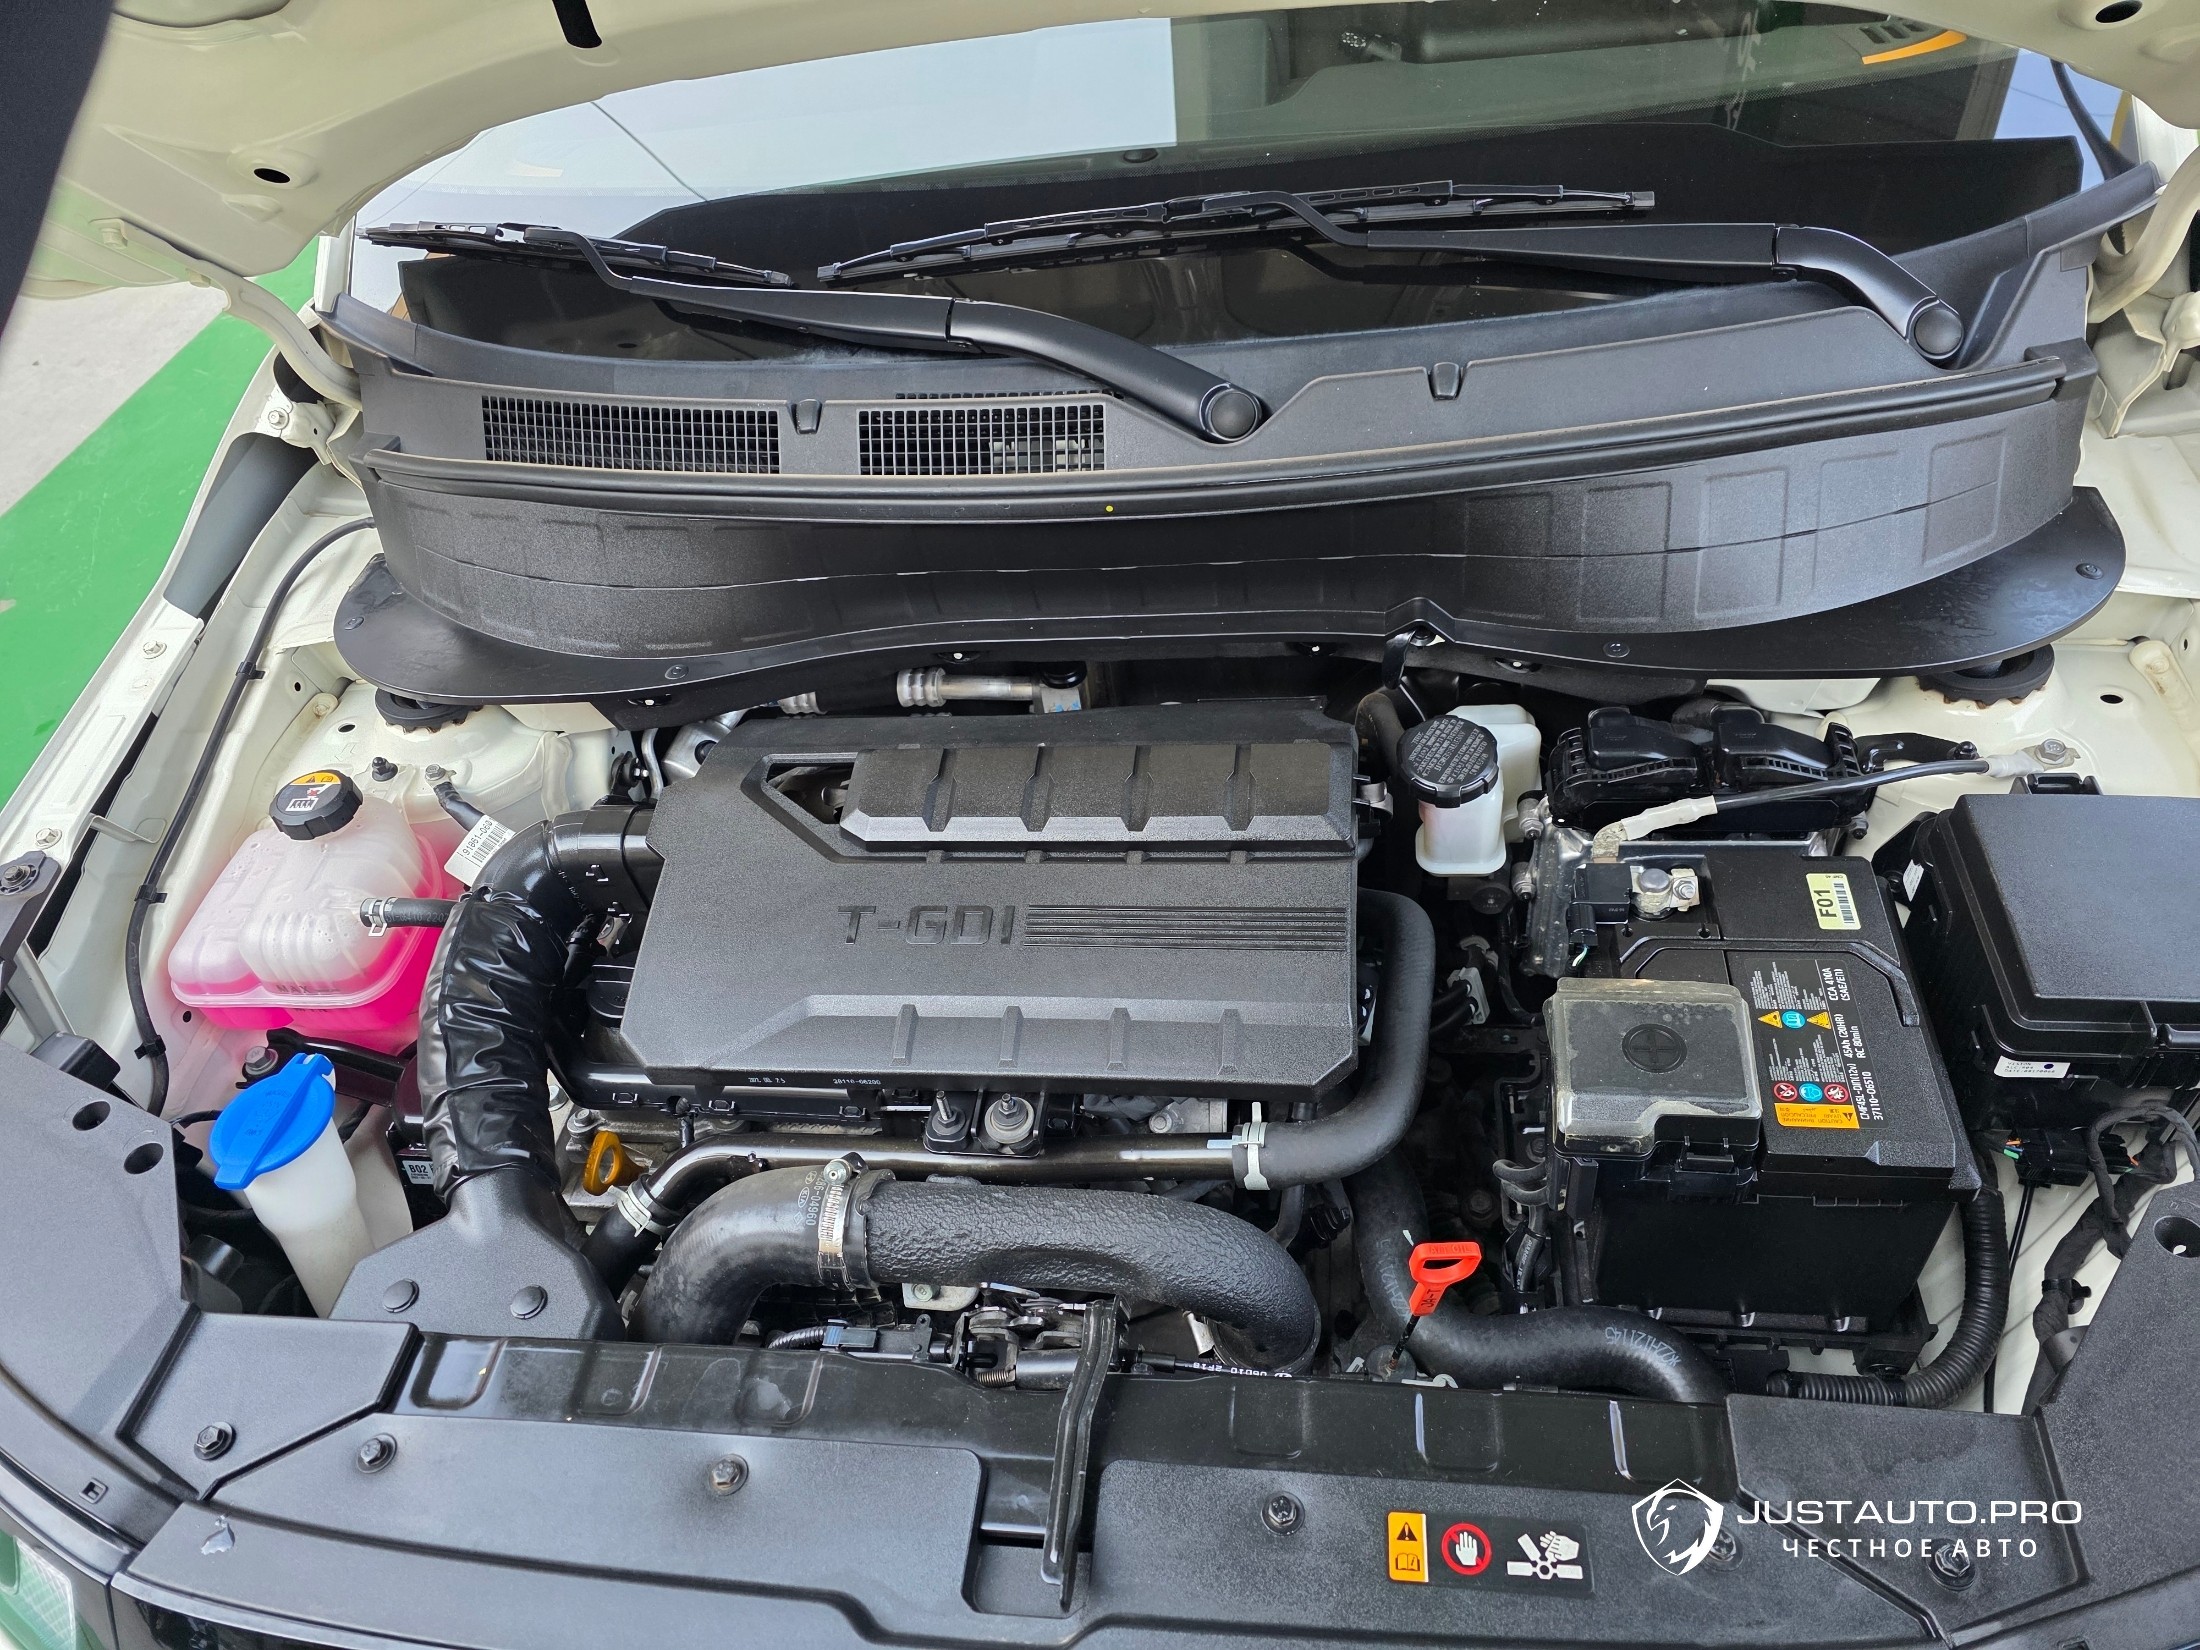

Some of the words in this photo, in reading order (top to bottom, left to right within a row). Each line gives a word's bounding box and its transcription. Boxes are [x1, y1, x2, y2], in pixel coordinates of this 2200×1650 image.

[1813, 890, 1838, 917] F01
[837, 904, 1016, 945] T-GDI
[1821, 967, 1834, 984] 410A
[1828, 983, 1838, 1001] CCA
[1856, 1046, 1866, 1058] RC
[408, 1164, 428, 1173] B02
[1452, 1244, 1472, 1253] OIL
